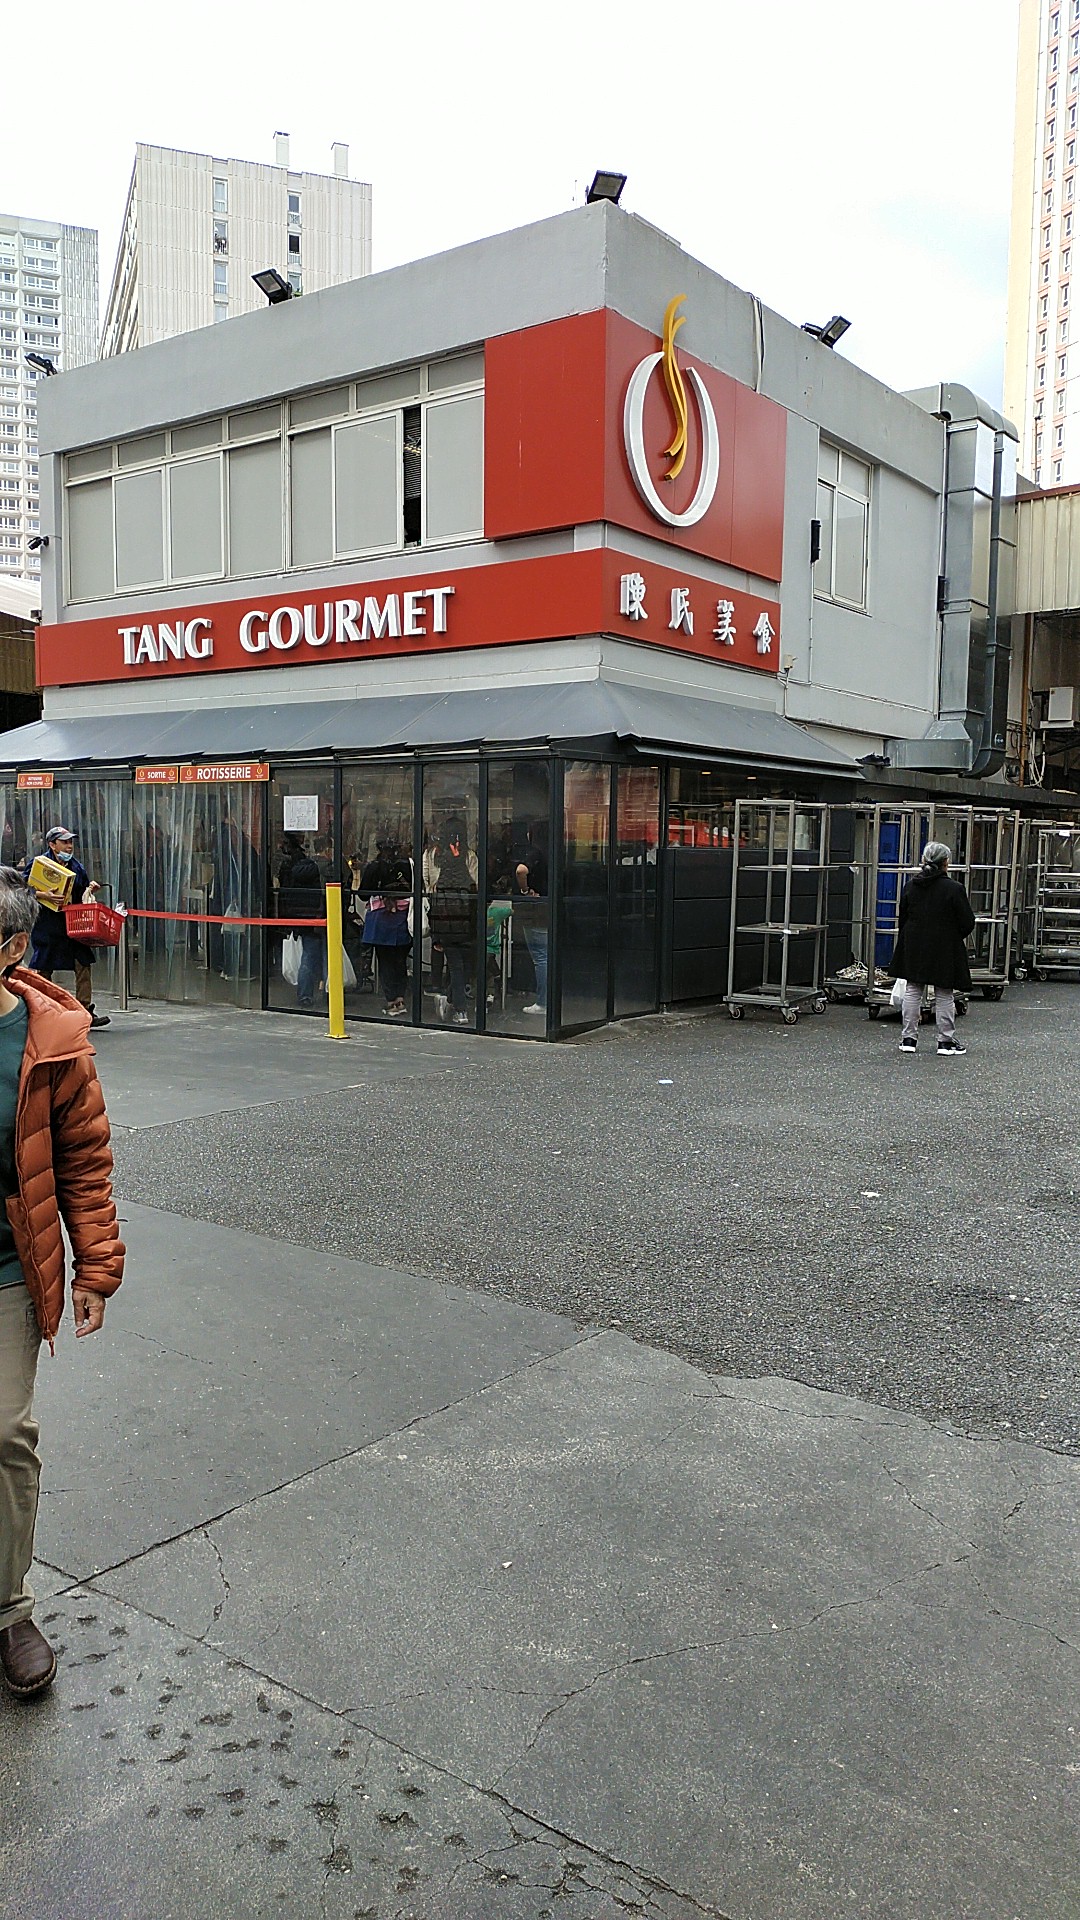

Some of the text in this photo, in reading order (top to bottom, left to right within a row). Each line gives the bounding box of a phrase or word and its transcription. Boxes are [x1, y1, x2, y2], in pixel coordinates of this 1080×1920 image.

[117, 586, 455, 665] TANG GOURMET
[147, 771, 166, 779] SORTIE
[196, 767, 252, 780] ROTISSERIE
